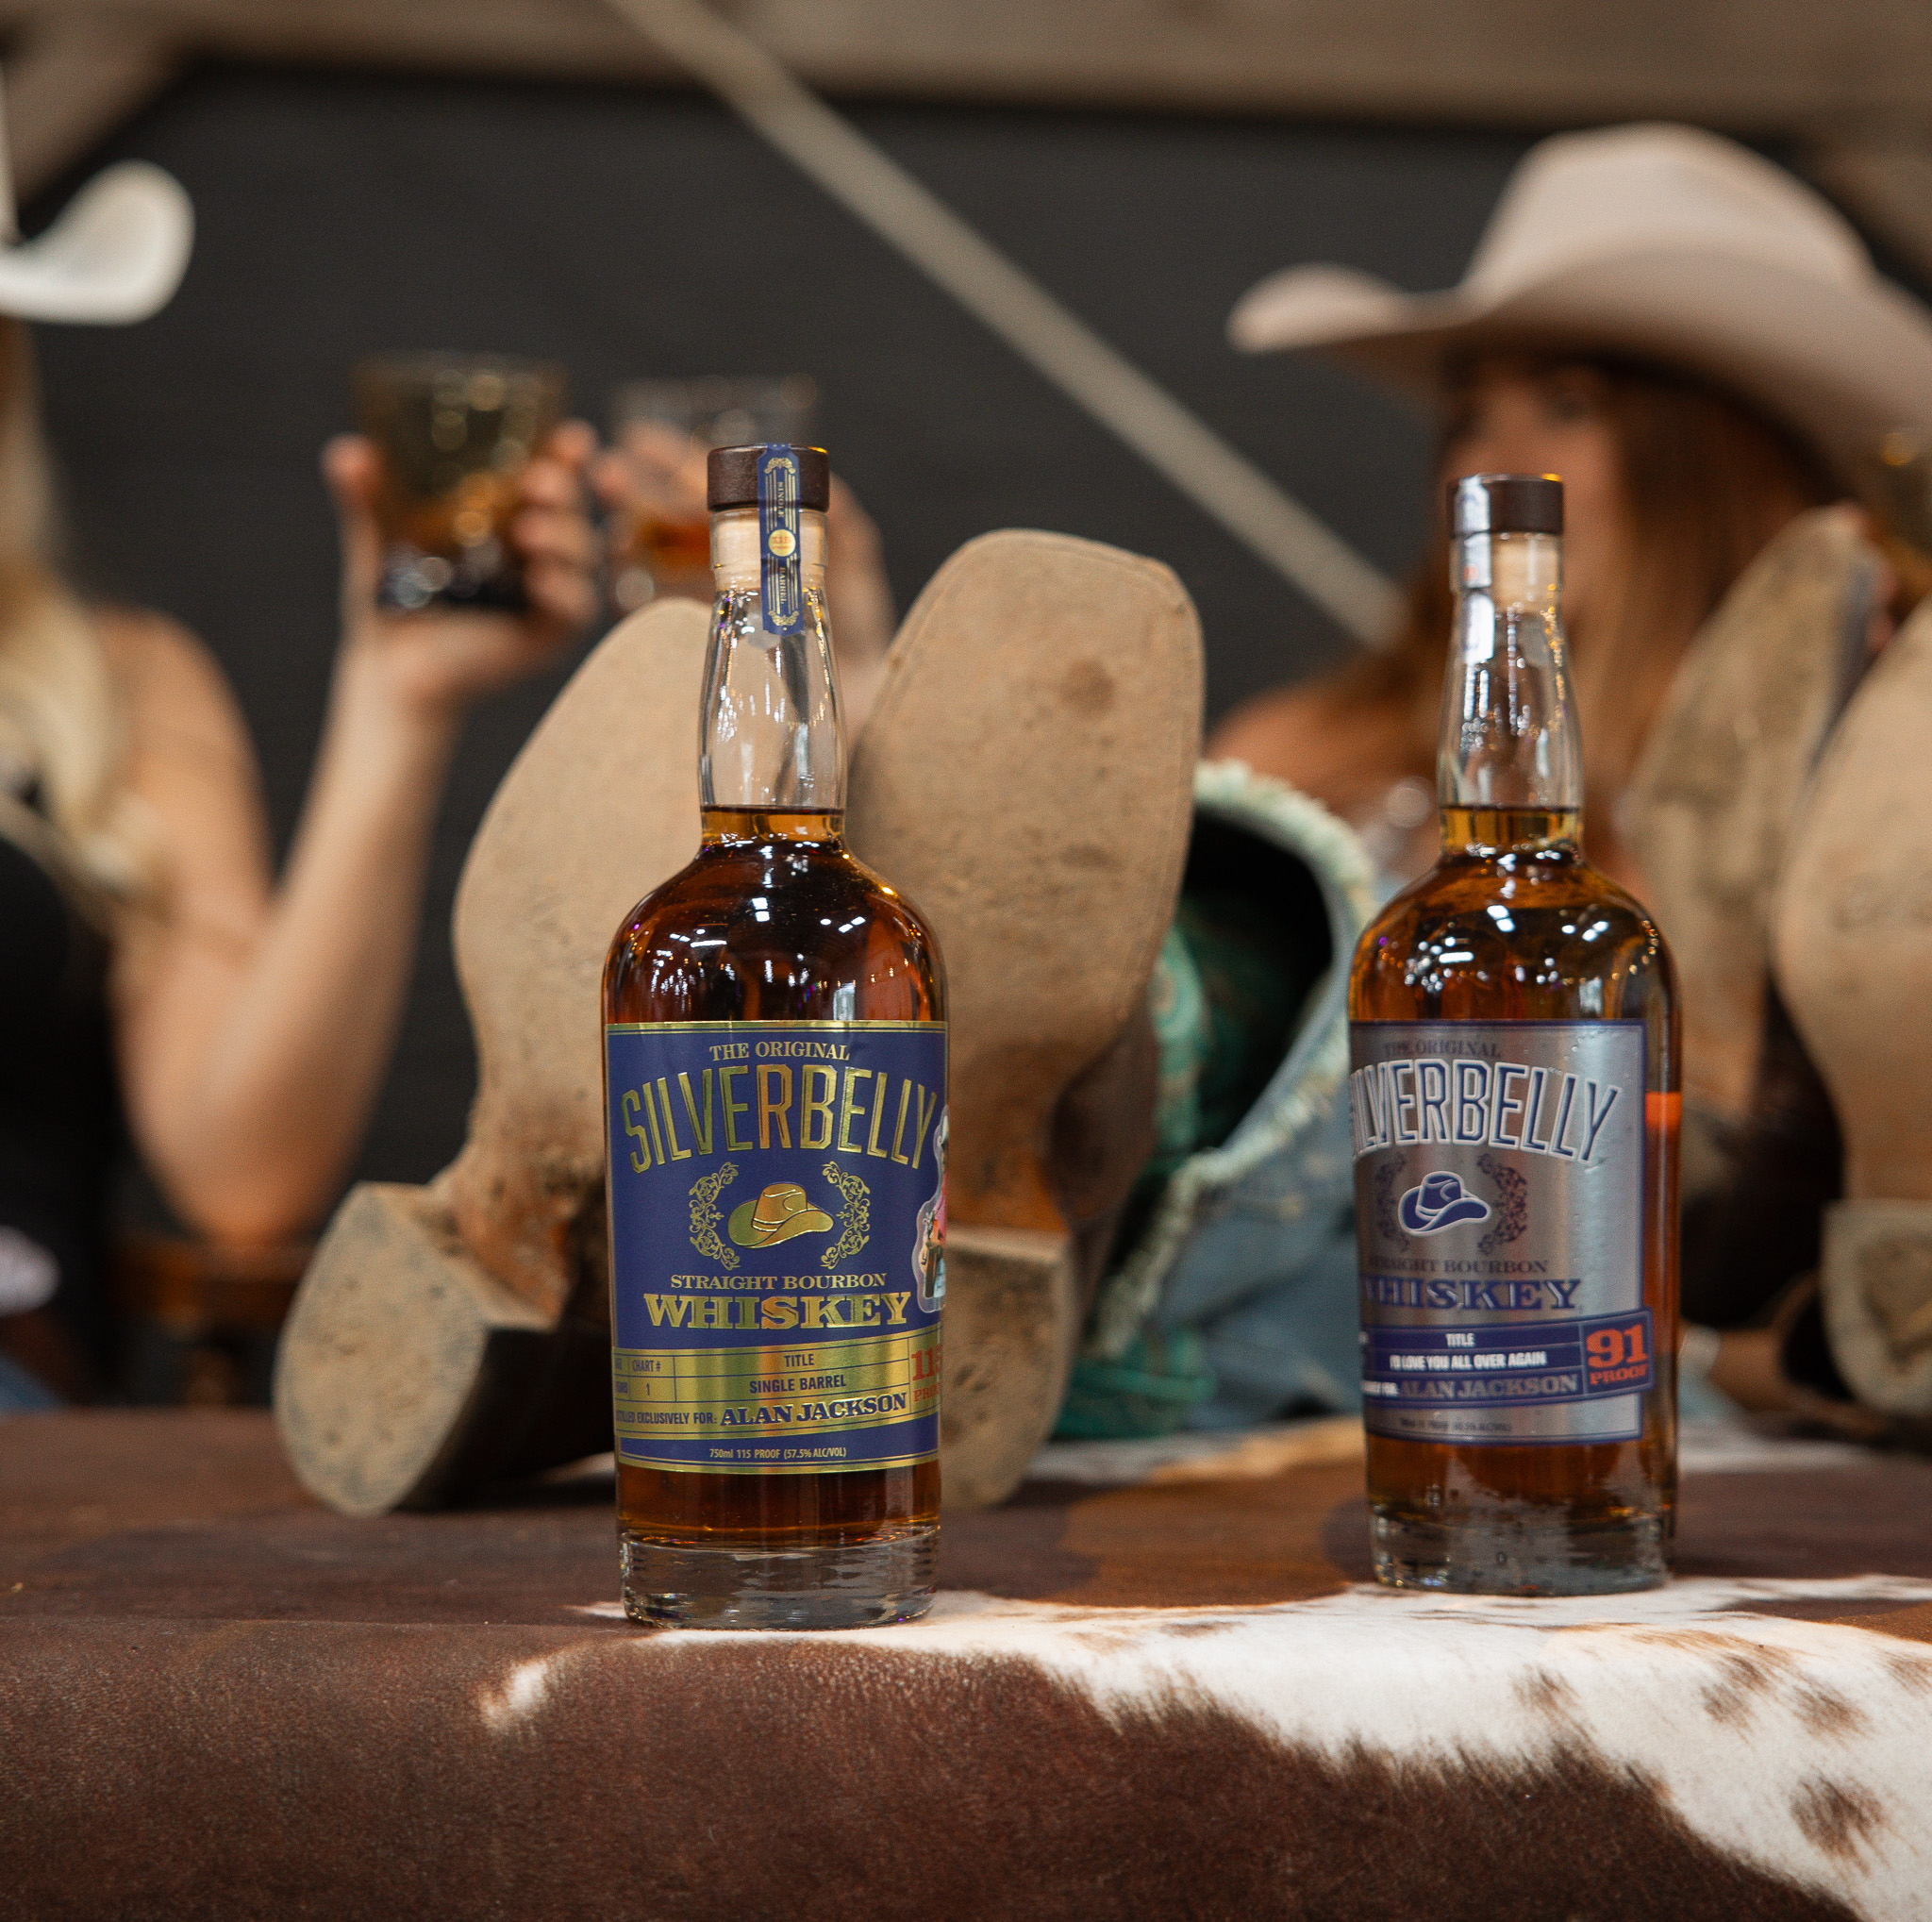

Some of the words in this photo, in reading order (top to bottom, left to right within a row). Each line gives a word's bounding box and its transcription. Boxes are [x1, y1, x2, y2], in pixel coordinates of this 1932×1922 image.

[709, 1042, 750, 1061] THE
[756, 1041, 850, 1061] ORIGINAL
[1416, 1040, 1501, 1058] ORIGINAL
[621, 1063, 938, 1174] SILVERBELLY
[1443, 1259, 1550, 1274] BOURBON
[671, 1274, 778, 1290] STRAIGHT
[781, 1272, 888, 1290] BOURBON
[643, 1291, 912, 1329] WHISKEY
[1444, 1332, 1475, 1348] TITLE
[1586, 1323, 1649, 1369] 91
[632, 1359, 655, 1373] CHART
[784, 1353, 815, 1367] TITLE
[1401, 1354, 1426, 1371] LOVE
[1426, 1354, 1451, 1371] YOU
[1451, 1354, 1474, 1371] ALL
[1474, 1353, 1507, 1370] OVER
[1507, 1351, 1547, 1368] AGAIN
[749, 1377, 795, 1395] SINGLE
[799, 1375, 847, 1392] BARREL
[1589, 1364, 1649, 1386] PROOF
[1401, 1379, 1456, 1399] ALAN
[1457, 1373, 1578, 1398] JACKSON
[637, 1411, 690, 1425] EXCLUSIVELY
[693, 1411, 717, 1425] FOR:
[720, 1405, 793, 1427] ALAN
[796, 1391, 908, 1423] JACKSON
[709, 1448, 734, 1459] 750ml
[737, 1448, 752, 1459] 115
[754, 1448, 781, 1459] PROOF
[783, 1447, 812, 1460] (57.5%
[812, 1446, 847, 1459] ALC/VOL)
